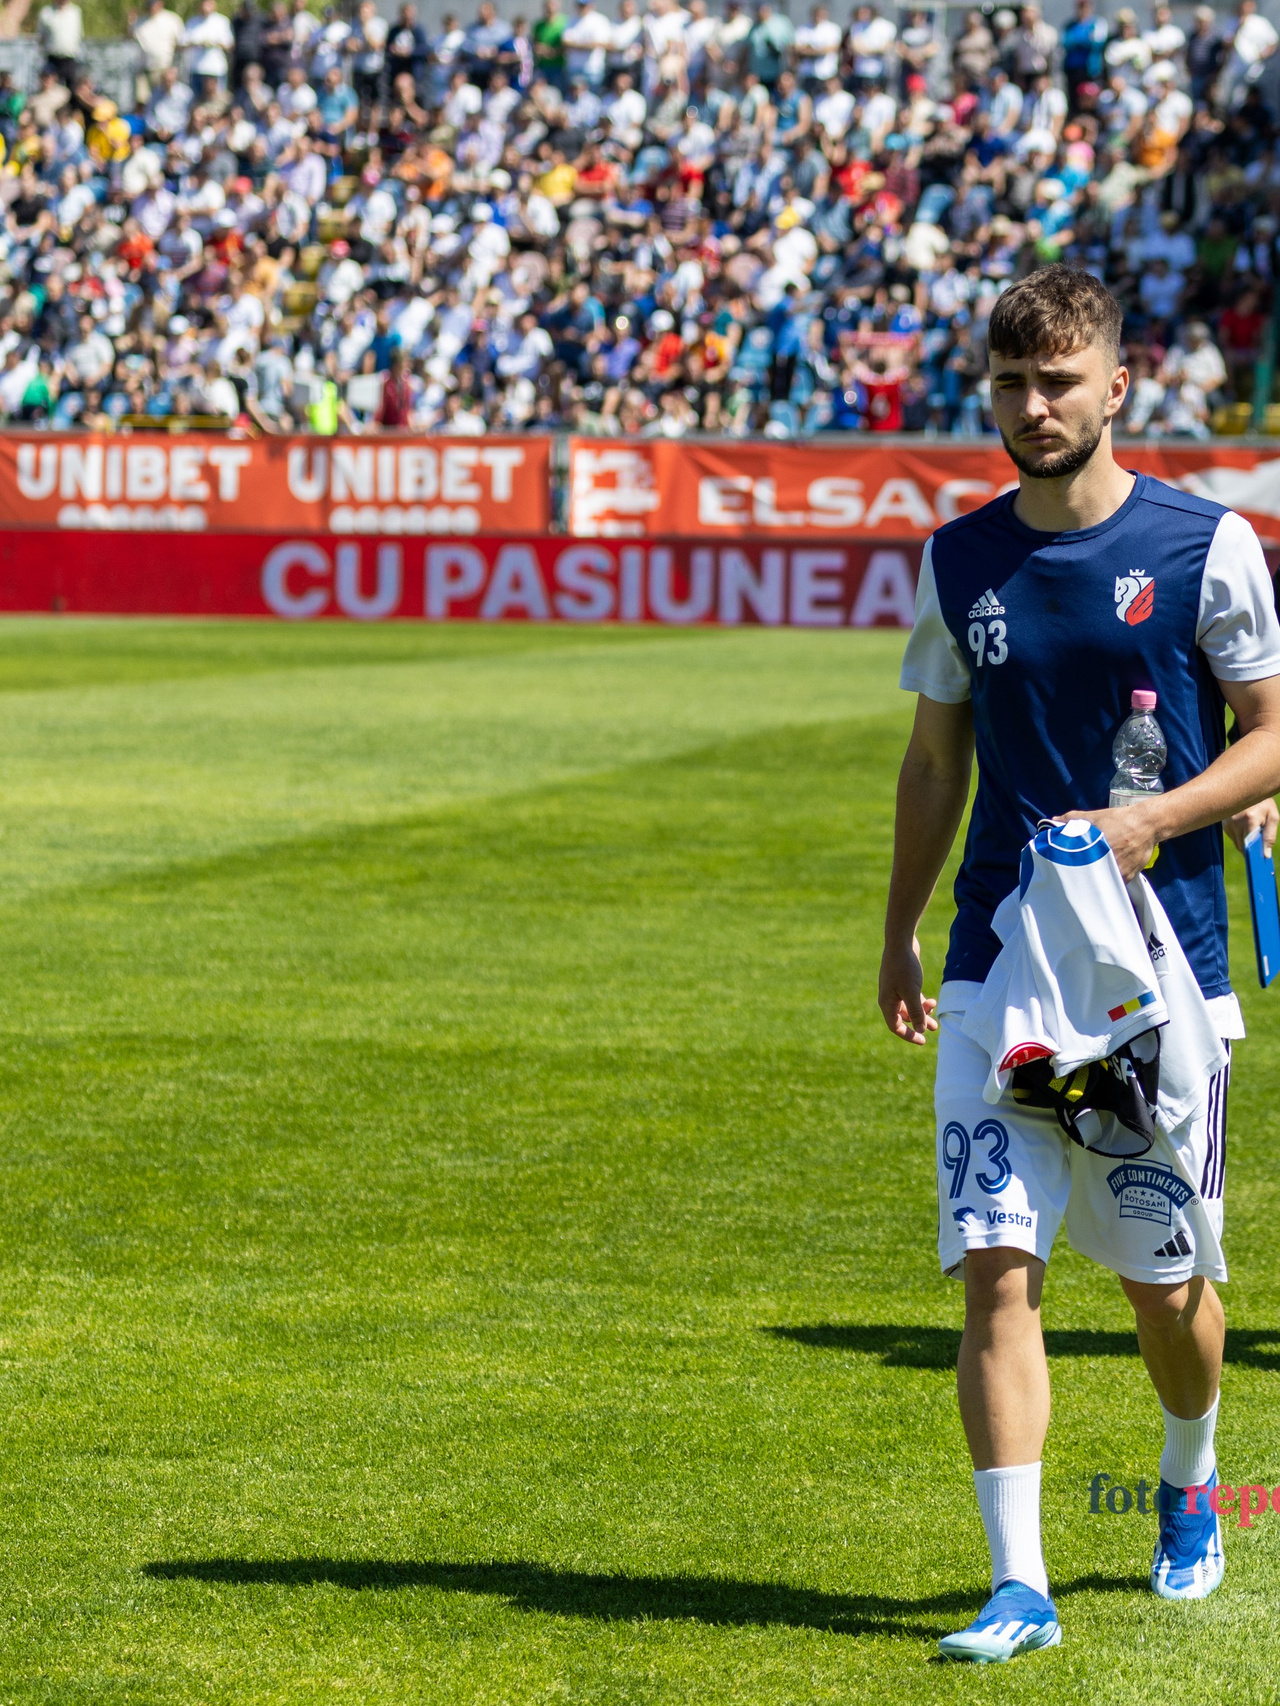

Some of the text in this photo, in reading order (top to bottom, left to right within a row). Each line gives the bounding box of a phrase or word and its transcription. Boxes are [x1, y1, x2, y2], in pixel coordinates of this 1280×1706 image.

[17, 443, 252, 502] UNIBET
[287, 445, 525, 503] UNIBET
[698, 476, 1020, 528] ELSAC
[262, 540, 916, 627] CU PASIUNEA
[968, 605, 1005, 619] adidas
[967, 619, 1008, 667] 93
[943, 1119, 1012, 1200] 93
[1110, 1169, 1189, 1202] FIVE CONTINENTS
[1124, 1193, 1166, 1208] BOTOSANI
[986, 1210, 1032, 1228] Vestra
[1132, 1209, 1153, 1217] GROUP
